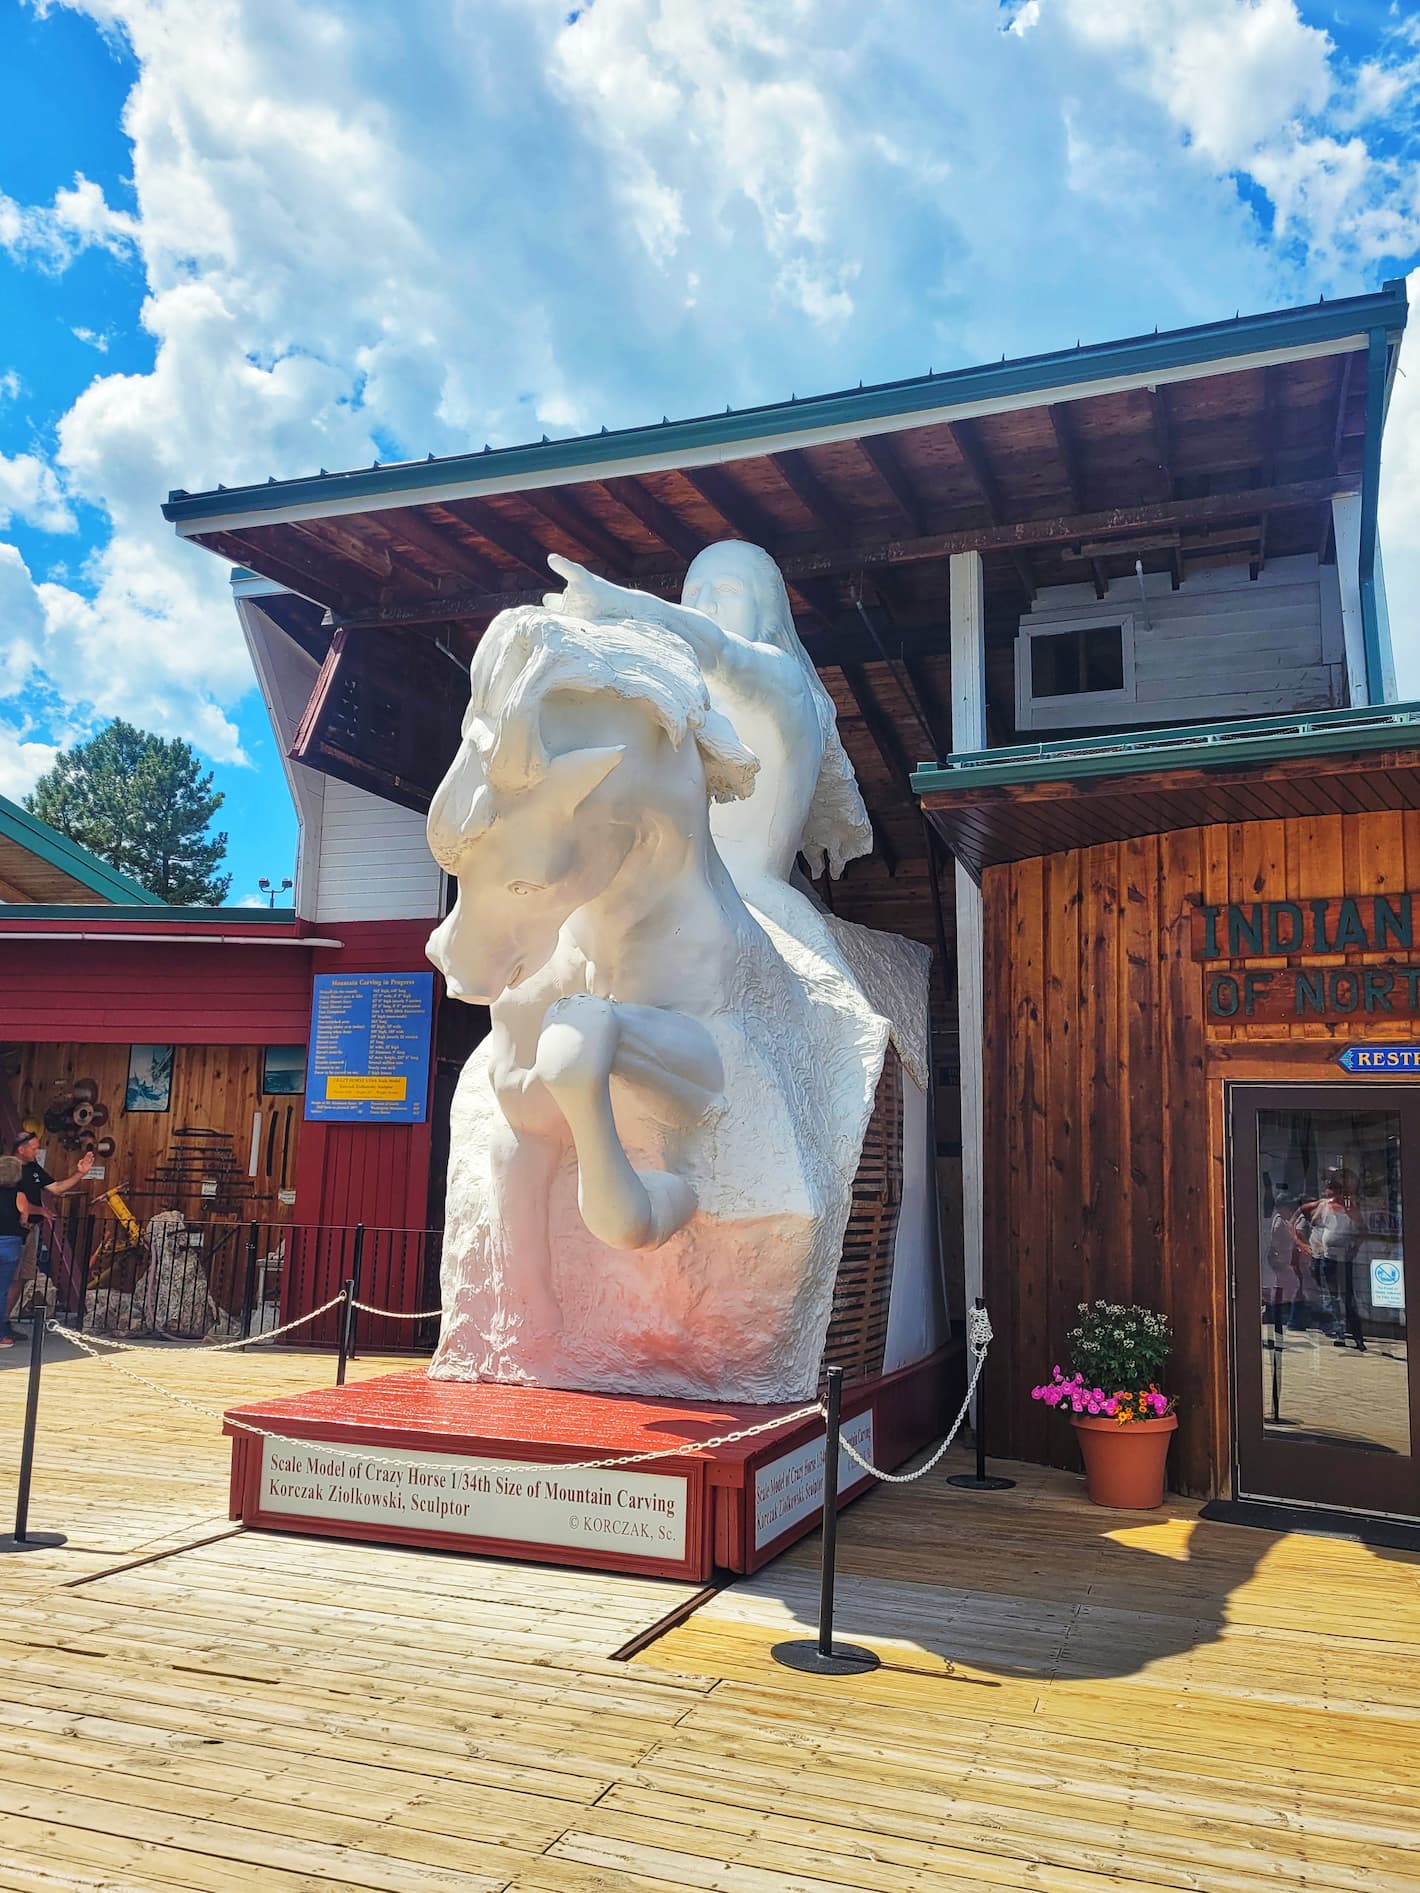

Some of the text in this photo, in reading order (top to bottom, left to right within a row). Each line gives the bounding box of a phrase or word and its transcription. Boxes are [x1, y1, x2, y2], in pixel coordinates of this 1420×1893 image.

[1201, 895, 1413, 957] INDIAN
[1210, 973, 1274, 1017] OF
[269, 1478, 471, 1519] Korczak Ziolkowski, Sculptor
[270, 1453, 676, 1518] Scale Model of Crazy Horse 1/34th Size of Mountain Carving
[583, 1516, 654, 1541] KORCZAK,
[658, 1525, 677, 1542] Sc.
